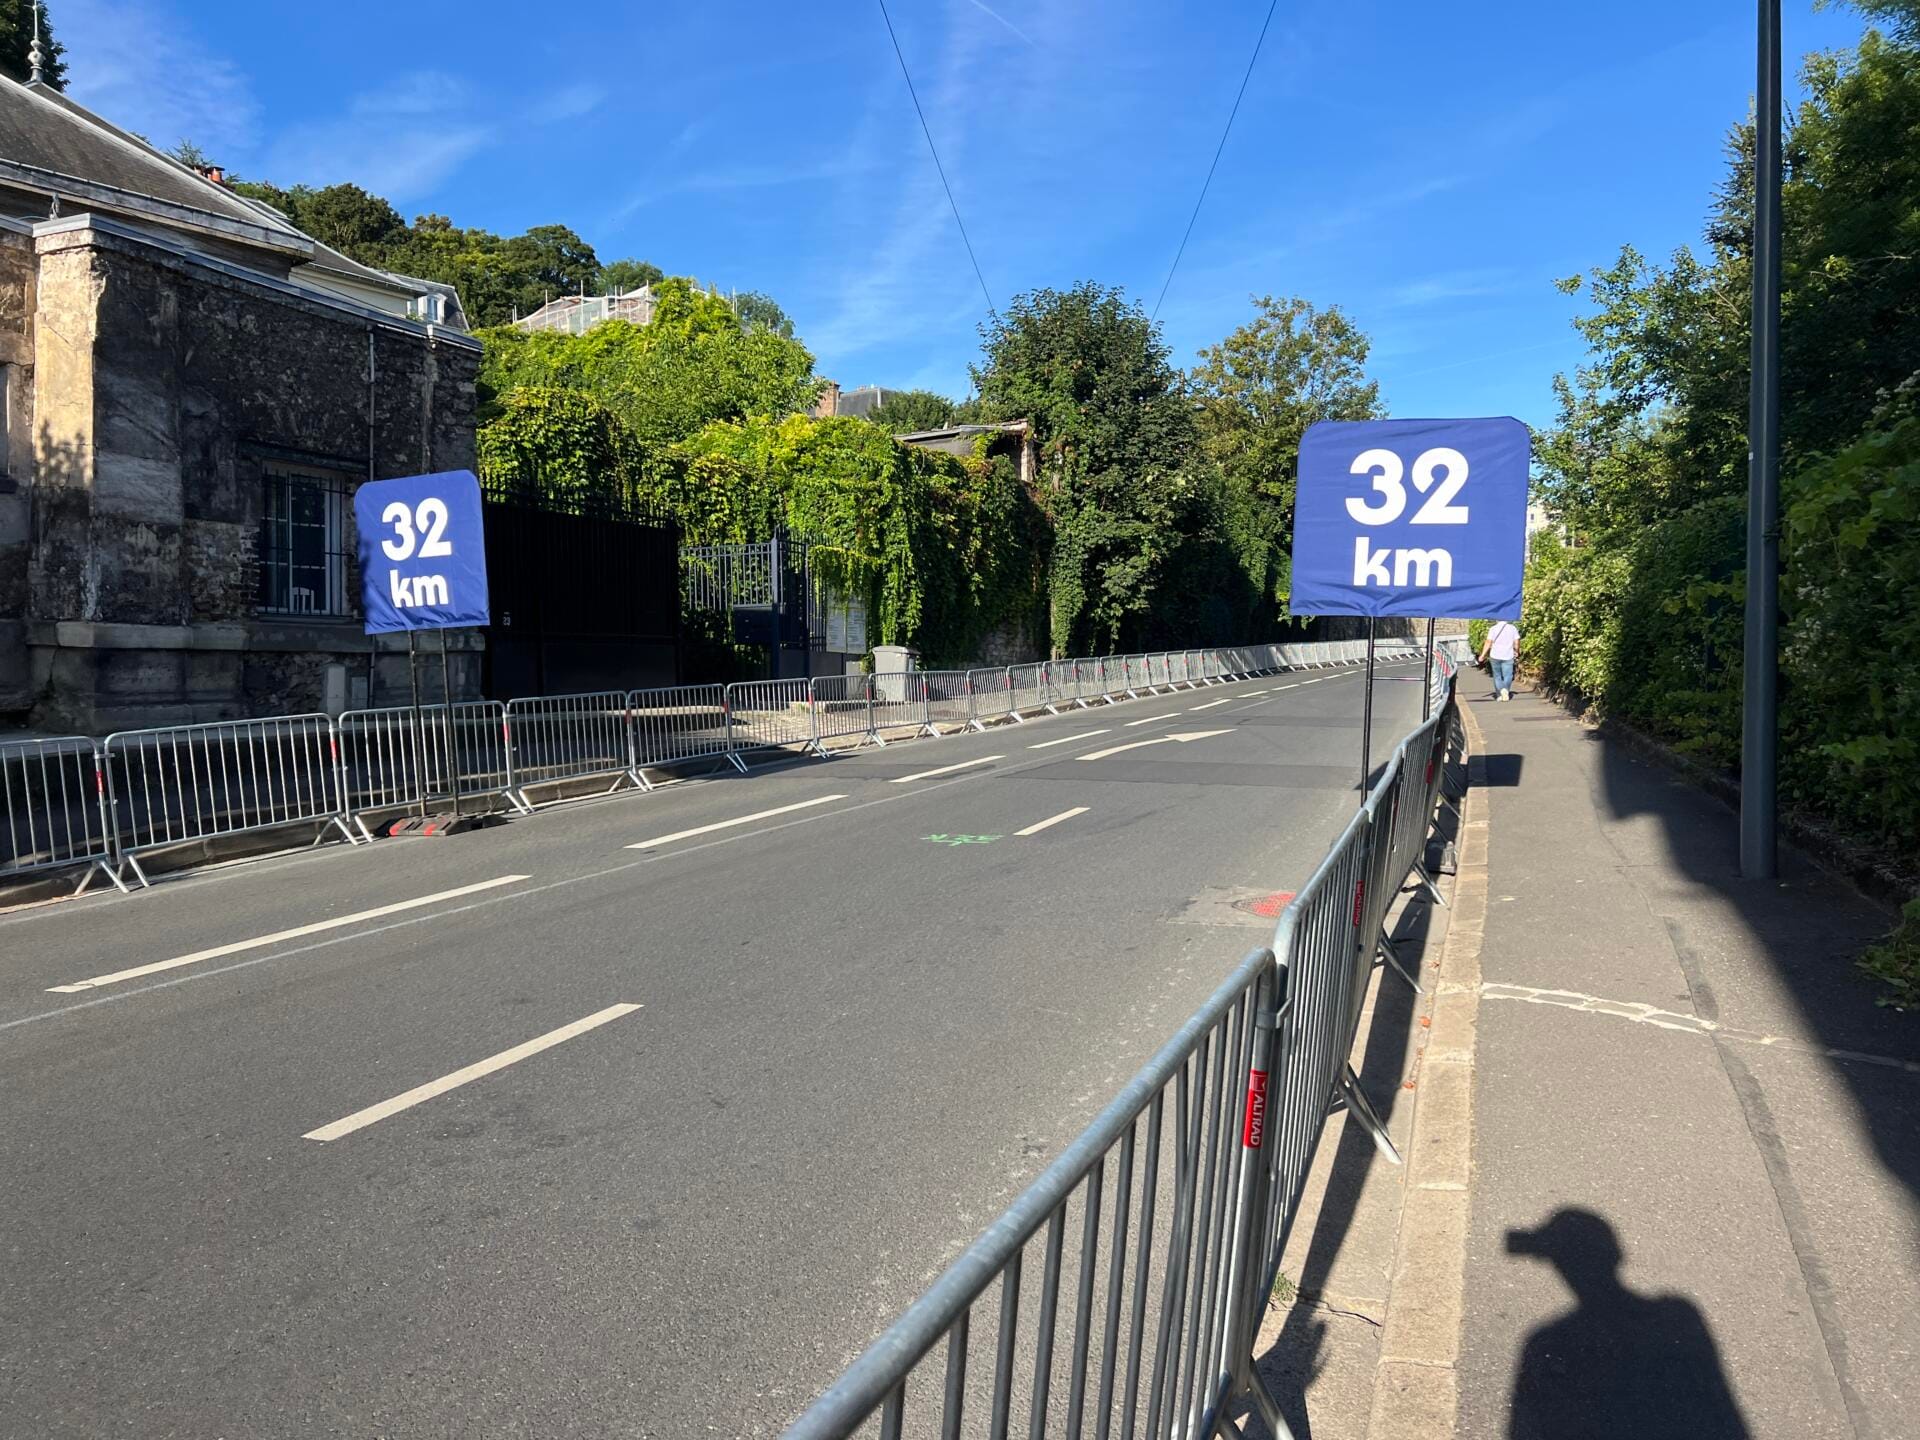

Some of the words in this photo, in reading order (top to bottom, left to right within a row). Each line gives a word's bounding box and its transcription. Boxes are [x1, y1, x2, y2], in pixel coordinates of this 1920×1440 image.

[1345, 447, 1469, 526] 32
[381, 497, 453, 562] 32
[1353, 536, 1453, 588] km
[389, 569, 449, 608] km
[1250, 1094, 1265, 1145] ALTRAD
